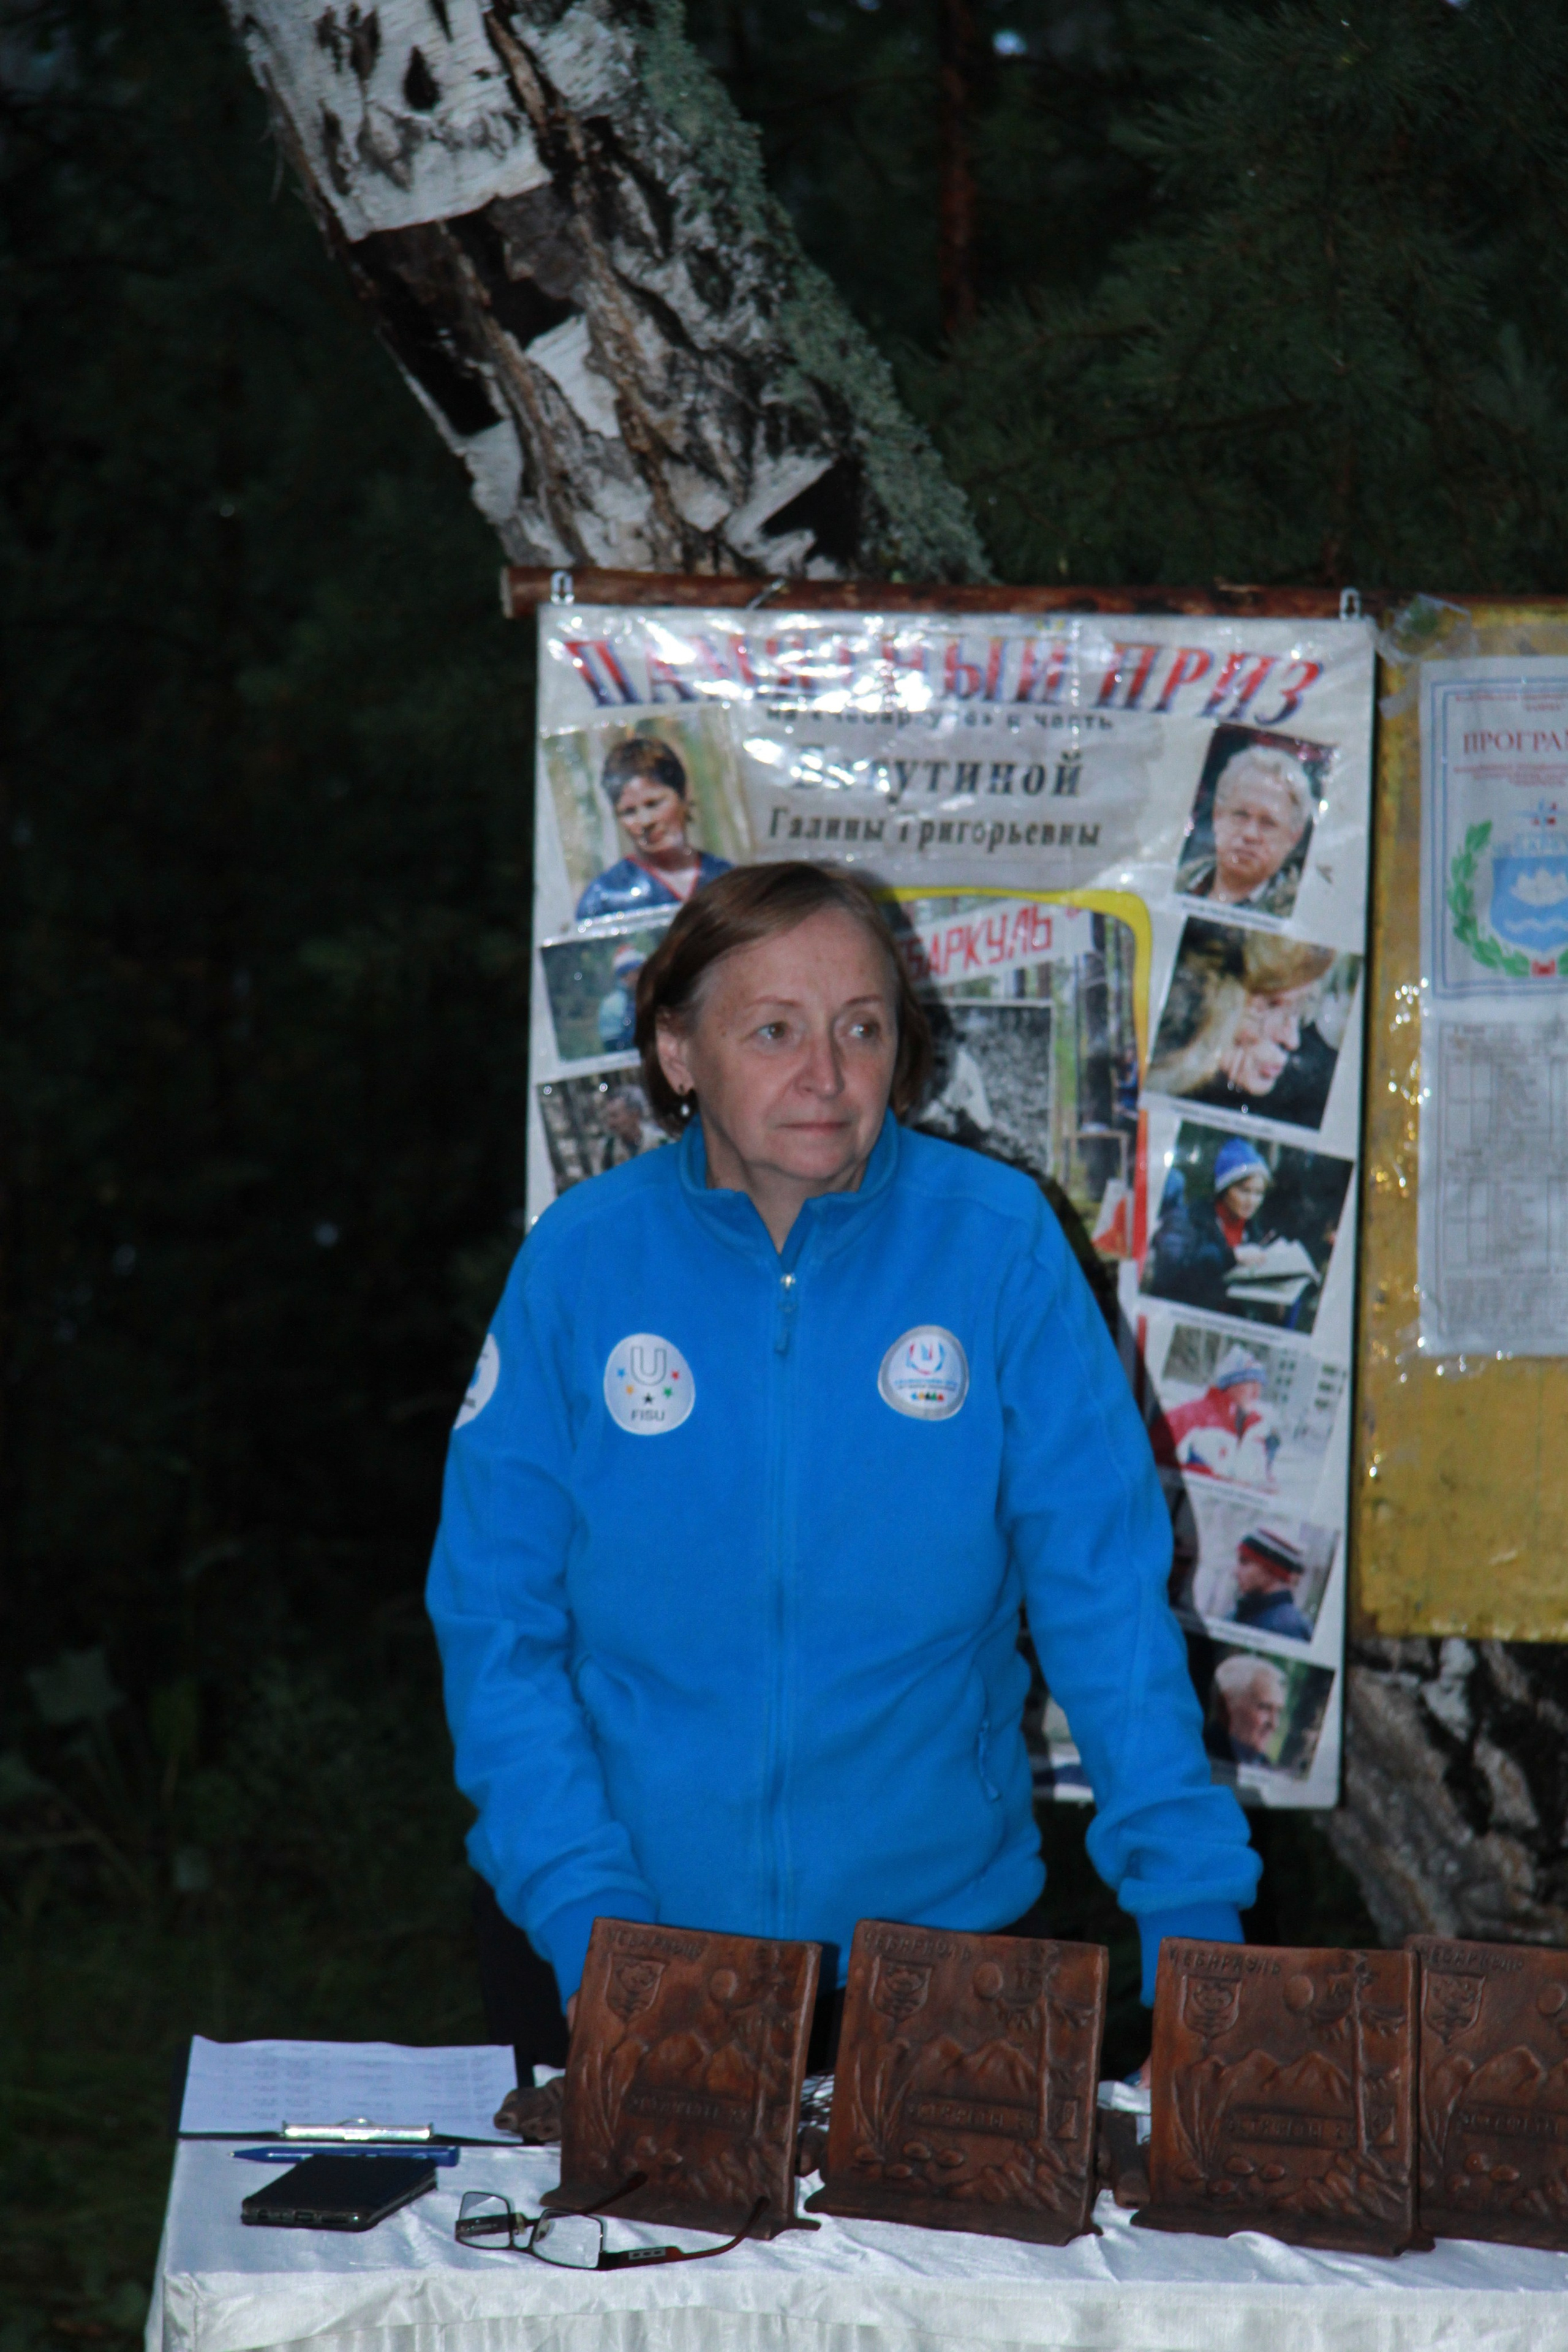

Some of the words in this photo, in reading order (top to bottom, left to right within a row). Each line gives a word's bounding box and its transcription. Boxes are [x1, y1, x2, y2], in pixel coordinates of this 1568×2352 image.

[1094, 642, 1324, 725] ПРИЗ
[1463, 729, 1568, 755] ПРОГРА
[769, 806, 884, 840] Галины
[899, 809, 1101, 853] Григорьевны
[631, 1409, 665, 1422] FISU
[1169, 1947, 1281, 1976] ЧЕБАРКУЛЬ
